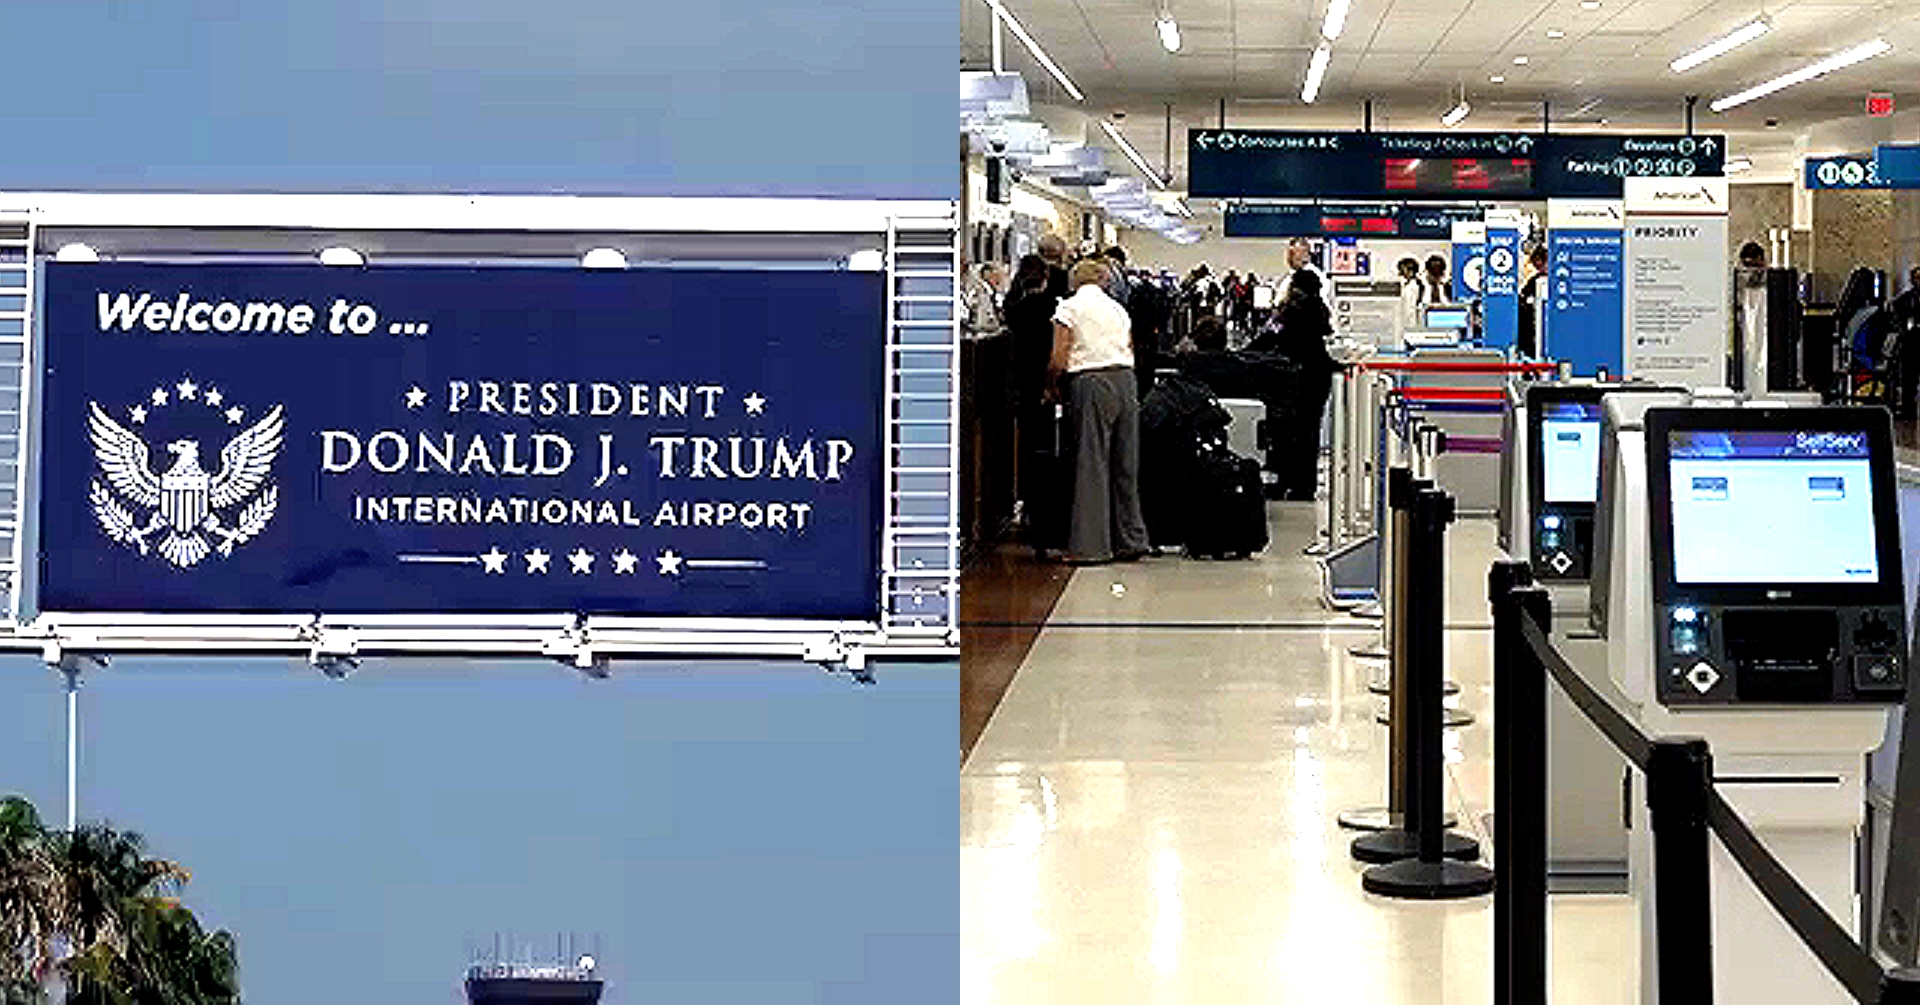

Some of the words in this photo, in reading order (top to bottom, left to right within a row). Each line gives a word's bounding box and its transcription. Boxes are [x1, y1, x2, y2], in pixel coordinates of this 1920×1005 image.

[1634, 226, 1699, 238] PRIORITY
[1496, 251, 1507, 268] 2
[97, 292, 315, 334] Welcome
[328, 298, 377, 335] to
[447, 380, 725, 418] PRESIDENT
[320, 429, 575, 475] DONALD
[592, 433, 629, 488] J.
[649, 435, 854, 482] TRUMP
[355, 495, 641, 526] INTERNATIONAL
[652, 499, 812, 530] AIRPORT
